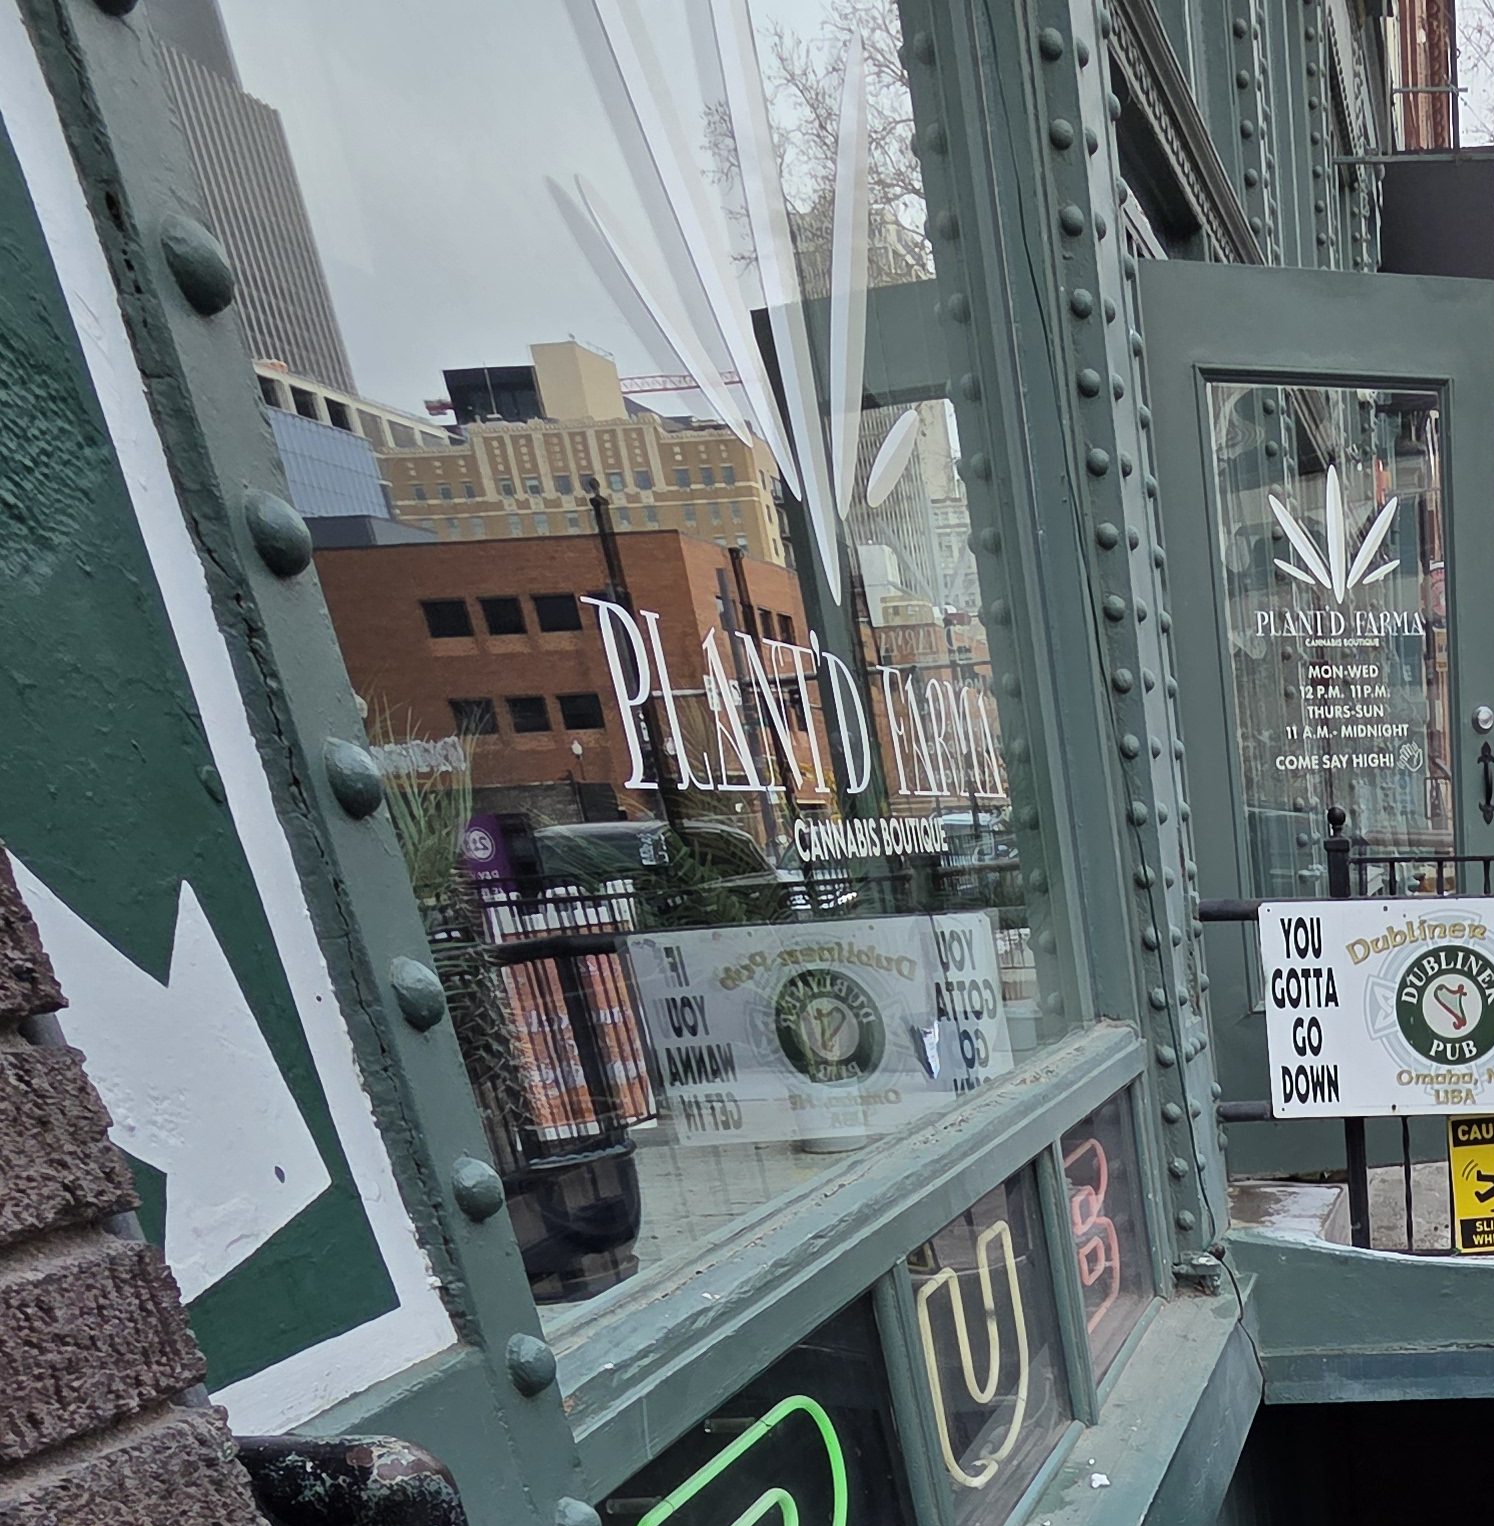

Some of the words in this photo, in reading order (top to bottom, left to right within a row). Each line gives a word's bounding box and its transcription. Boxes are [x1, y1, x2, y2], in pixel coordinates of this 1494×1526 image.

[1255, 605, 1345, 636] PLANT'D
[1354, 610, 1427, 636] FARMA
[1308, 665, 1379, 679] MON-WED
[580, 596, 872, 793] PLANT'D
[877, 665, 1007, 798] FARMA
[1300, 686, 1314, 699] 12
[1317, 686, 1345, 699] P.M.
[1350, 685, 1361, 698] 11
[1307, 705, 1384, 719] THURS-SUN
[1286, 726, 1297, 739] 11
[1341, 724, 1409, 738] MIDNIGHT
[1275, 756, 1319, 770] COME
[1322, 754, 1349, 769] SAY
[1352, 754, 1394, 768] HIGH!
[794, 818, 881, 862] CANNABIS
[880, 817, 949, 856] BOUTIQUE
[1280, 916, 1322, 959] YOU
[1345, 919, 1488, 965] Dubliner
[1271, 967, 1339, 1009] GOTTA
[1293, 1017, 1323, 1057] GO
[1429, 1039, 1478, 1061] PUB
[1281, 1065, 1340, 1105] DOWN
